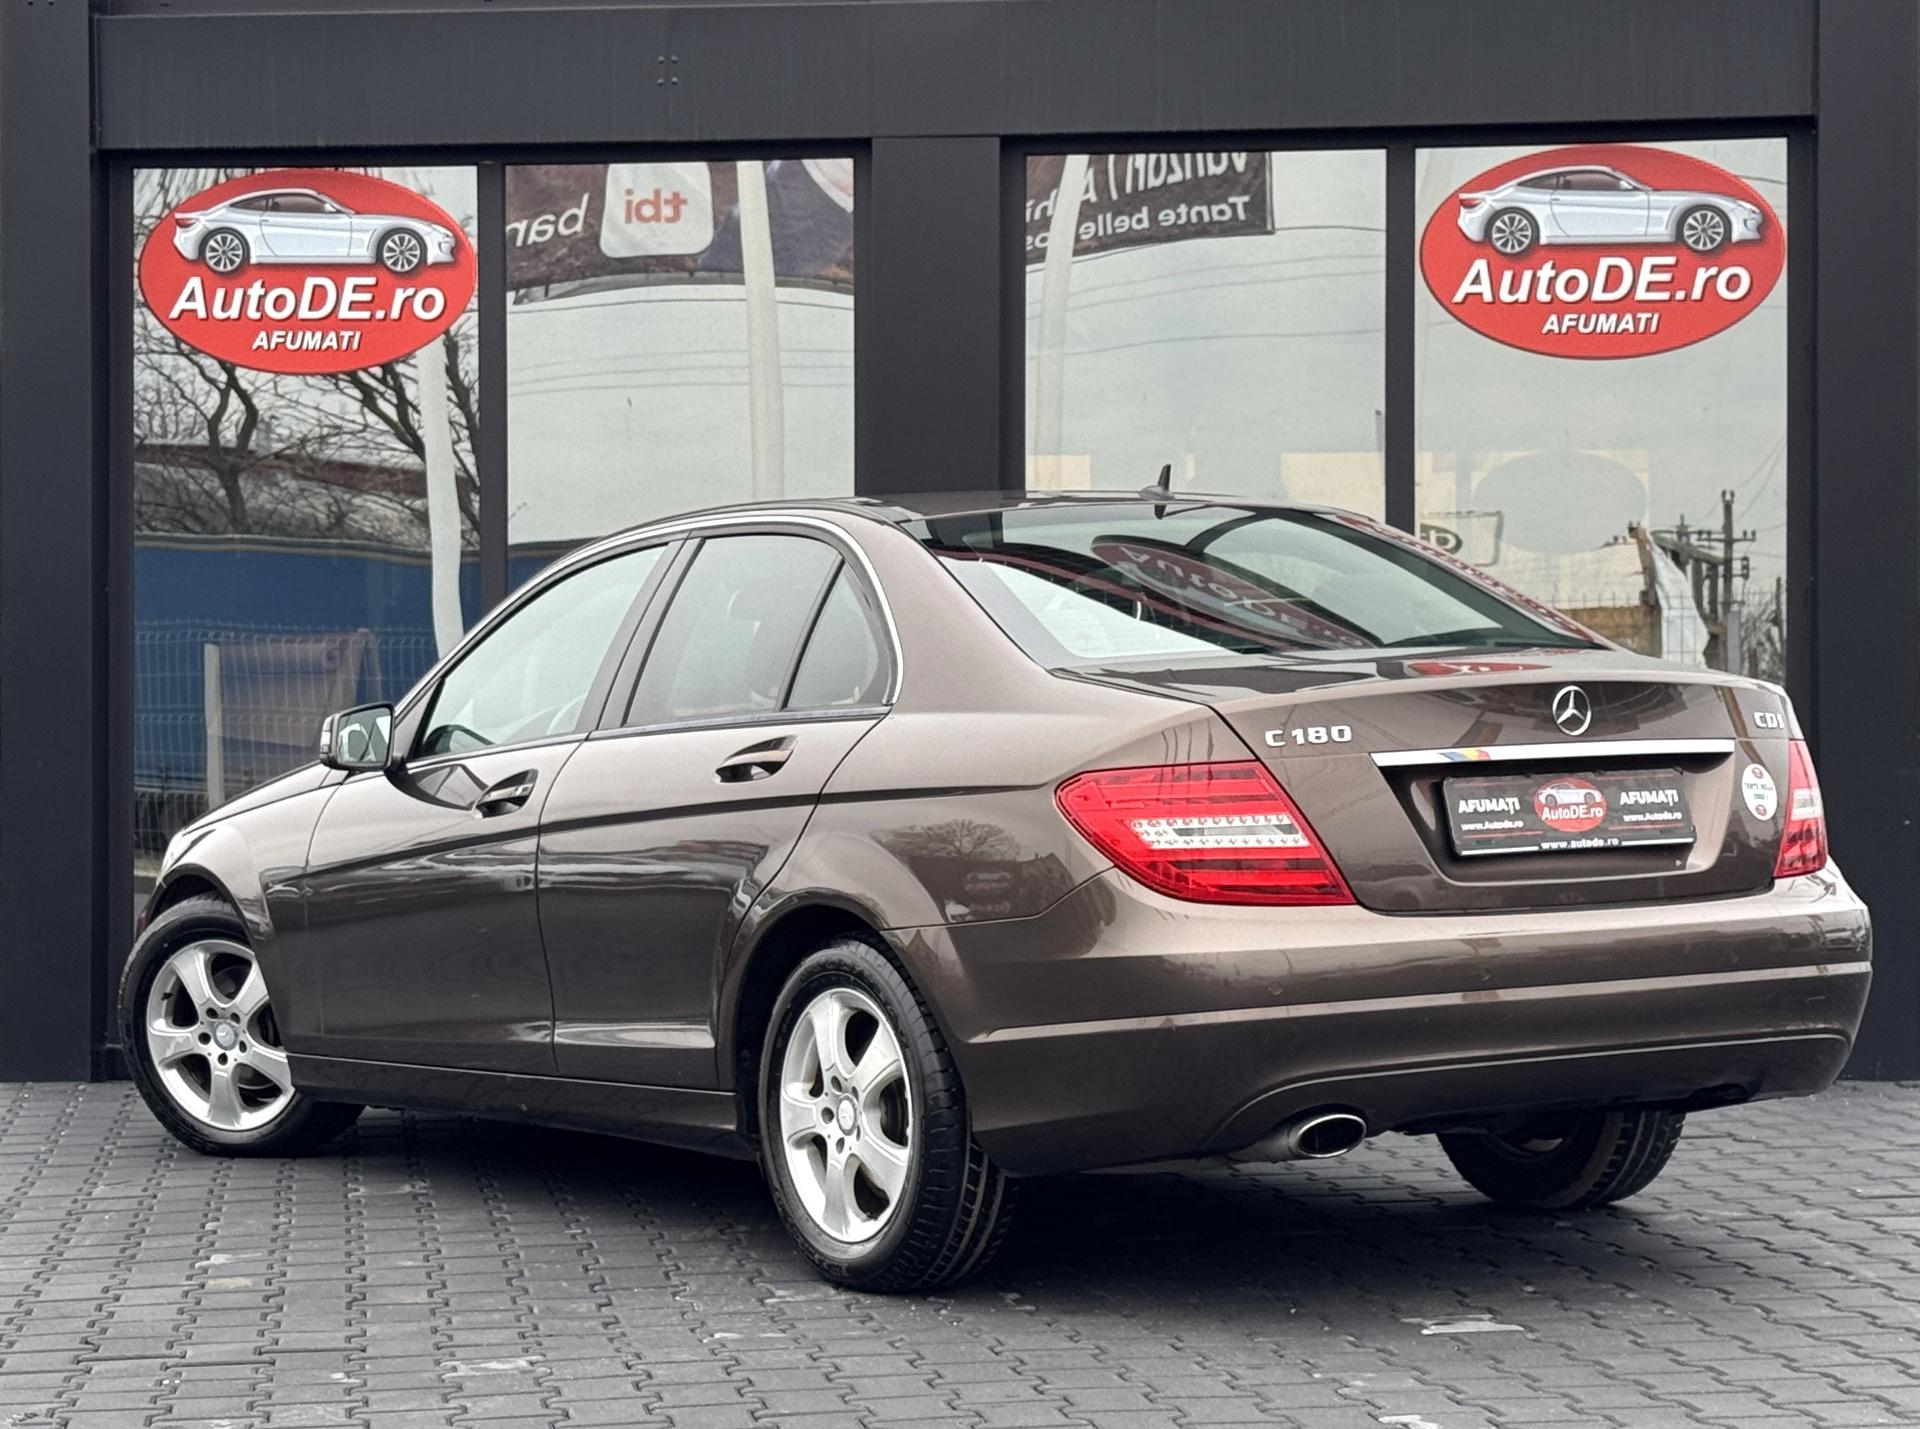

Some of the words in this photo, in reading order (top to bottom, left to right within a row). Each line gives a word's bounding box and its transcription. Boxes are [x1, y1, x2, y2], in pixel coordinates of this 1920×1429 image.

[1452, 255, 1752, 303] AutoDE.ro
[168, 276, 446, 321] AutoDE.ro
[1542, 312, 1659, 335] AFUMATI
[252, 330, 361, 351] AFUMATI
[1753, 711, 1785, 729] CDI
[1264, 729, 1286, 747] C
[1291, 725, 1352, 745] 180
[1542, 804, 1604, 821] AutoDE.ro
